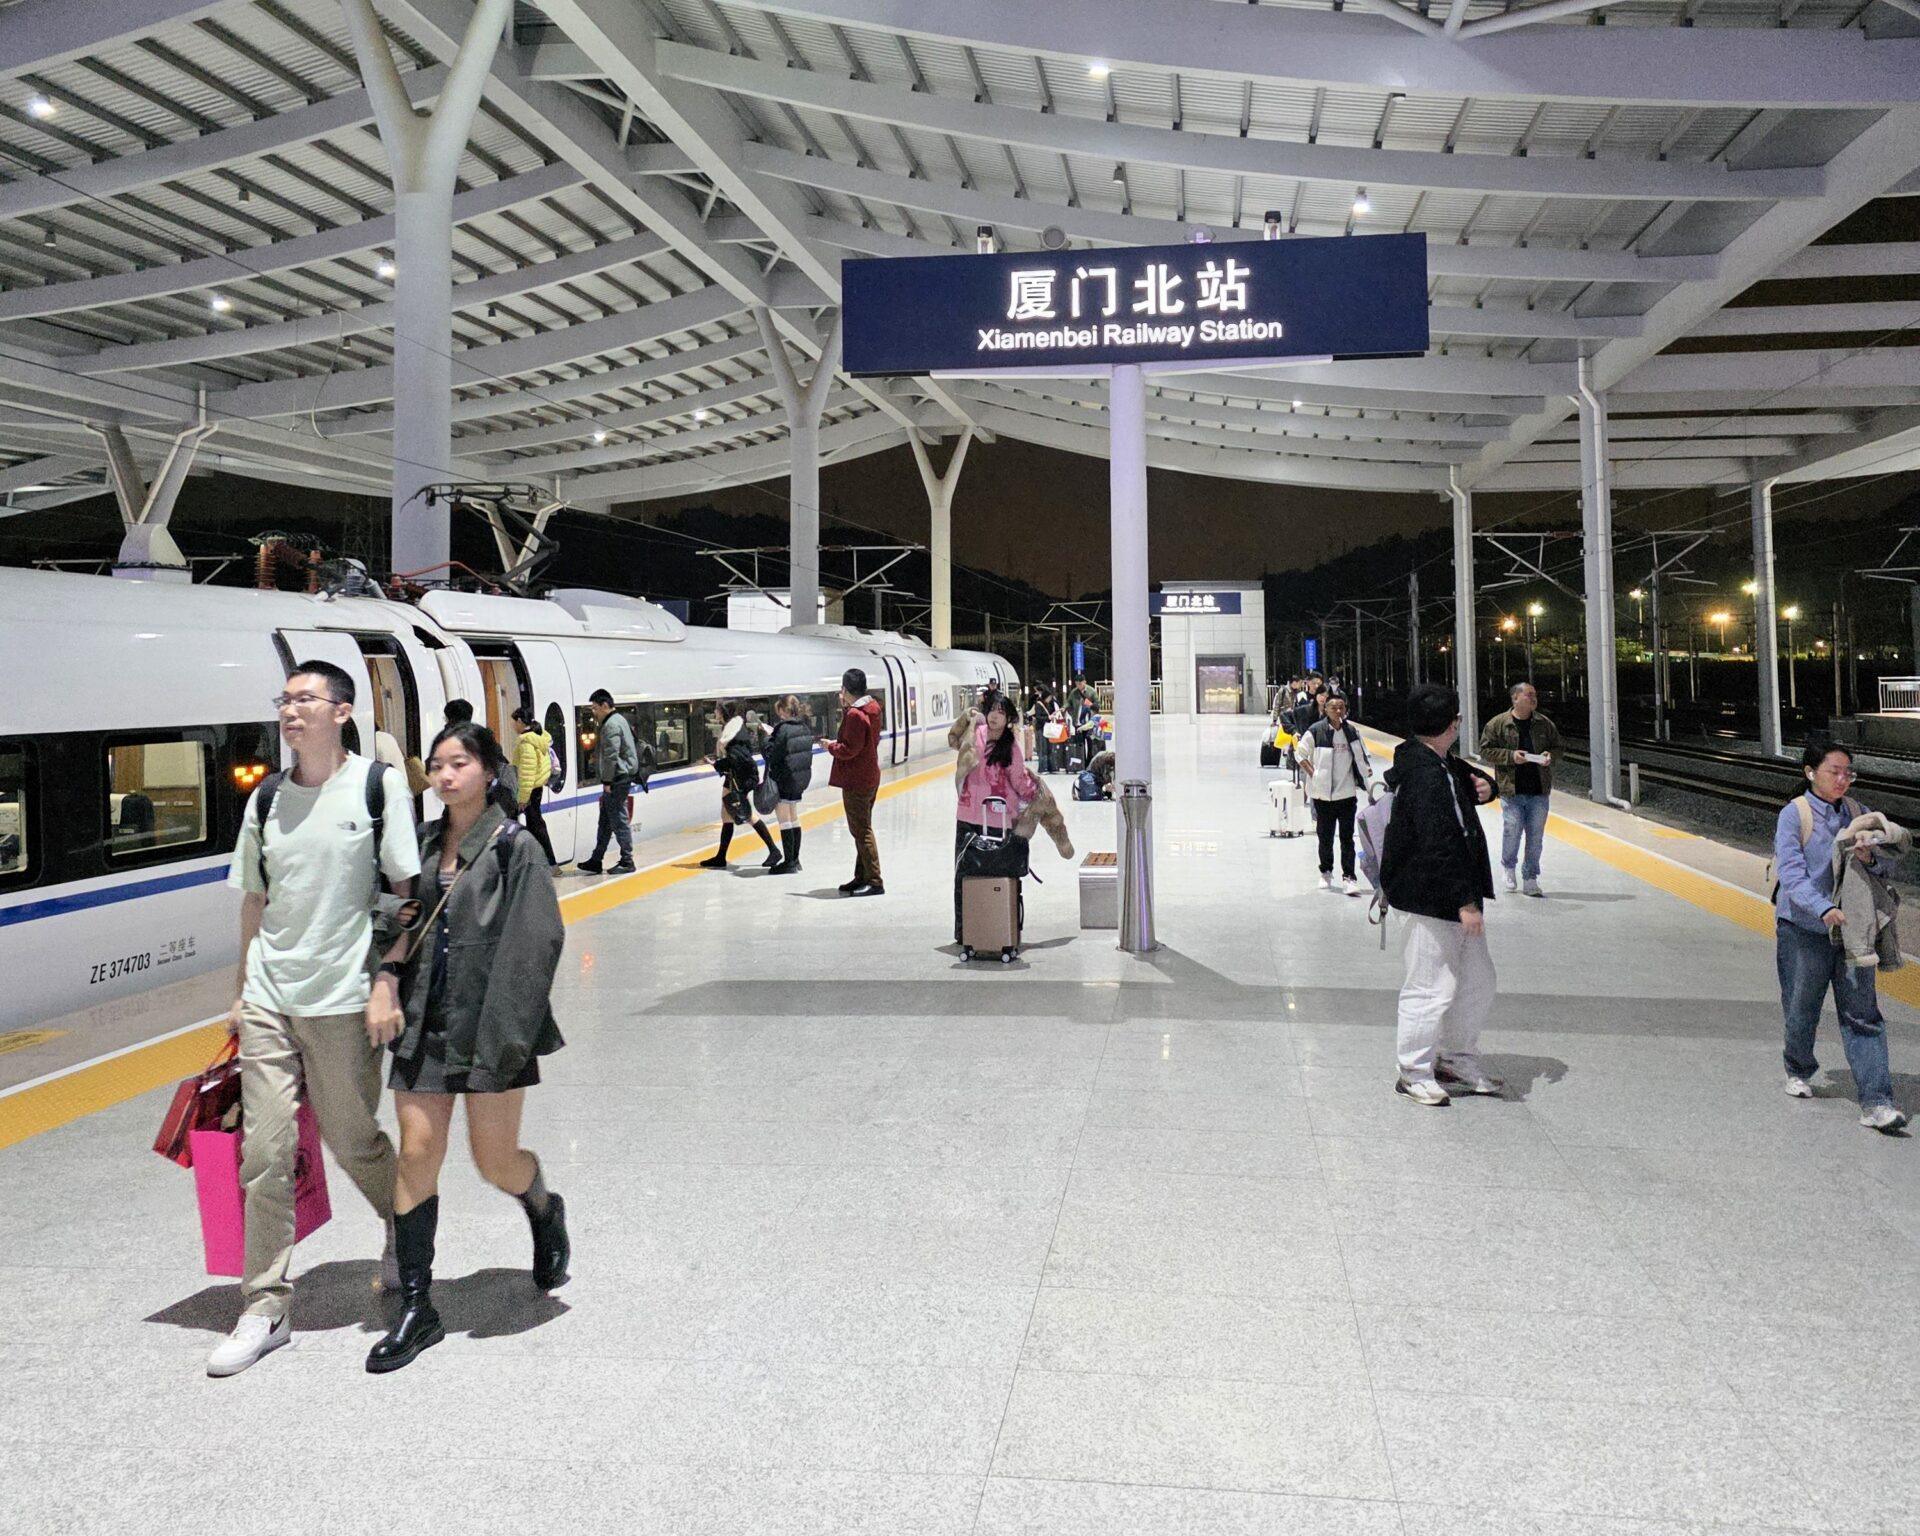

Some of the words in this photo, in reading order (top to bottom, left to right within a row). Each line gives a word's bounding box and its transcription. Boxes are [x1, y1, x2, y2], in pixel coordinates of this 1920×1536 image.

[1007, 259, 1251, 321] 厦门北站
[978, 325, 1098, 351] Xiamenbei
[1103, 322, 1196, 348] Railway
[1199, 317, 1283, 343] Station
[90, 963, 107, 984] ZE
[109, 952, 151, 979] 374703
